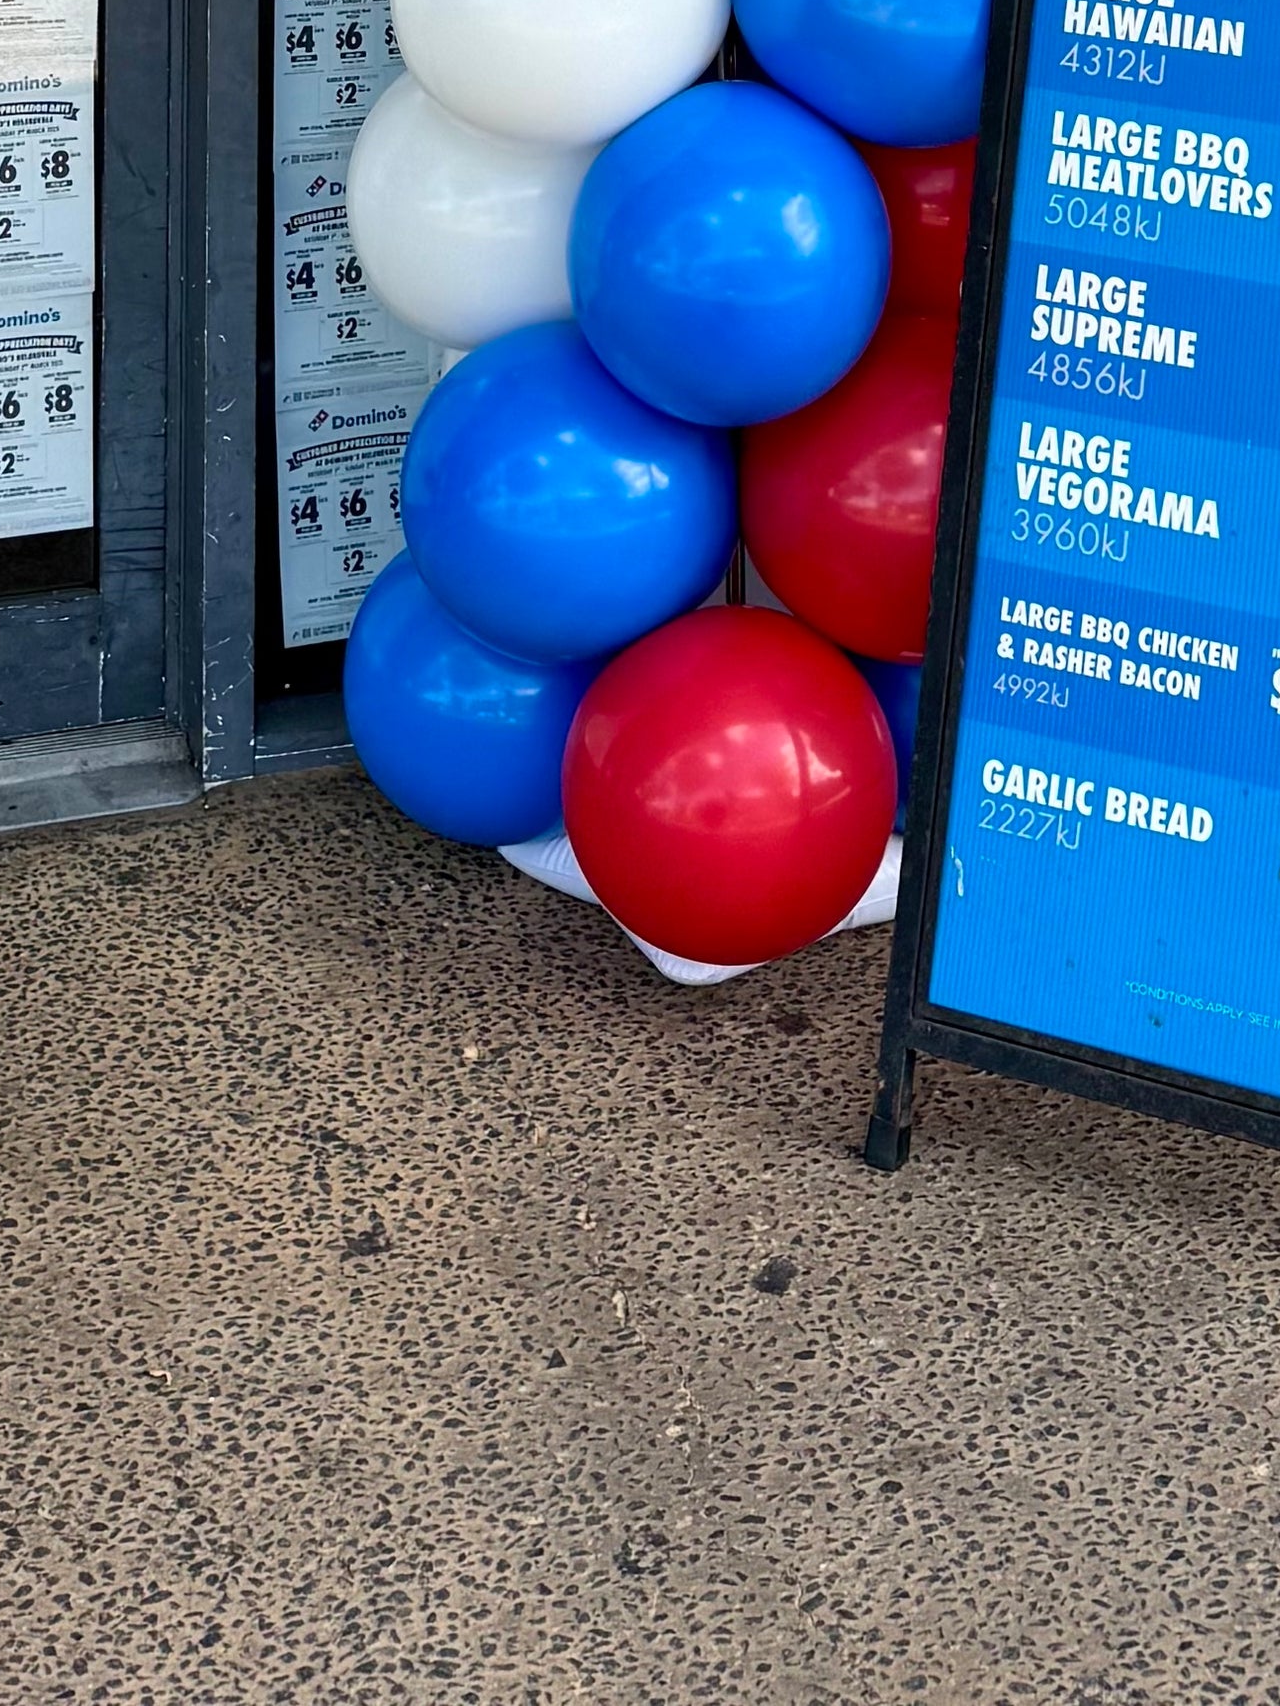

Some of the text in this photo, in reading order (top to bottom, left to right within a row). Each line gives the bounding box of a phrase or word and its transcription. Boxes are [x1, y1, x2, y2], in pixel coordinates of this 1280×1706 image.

[1063, 0, 1245, 57] HAWAIIAN
[1059, 42, 1166, 86] 4312kJ
[1052, 110, 1250, 178] LARGE BBQ
[1046, 149, 1274, 219] MEATLOVERS
[1043, 193, 1163, 242] 5048kJ
[1035, 264, 1148, 318] LARGE
[1030, 304, 1198, 369] SUPREME
[44, 384, 74, 414] $8
[1027, 350, 1147, 401] 4856kJ
[1019, 421, 1132, 478] LARGE
[1016, 461, 1221, 539] VEGORAMA
[1011, 508, 1129, 563] 3960kJ
[1000, 597, 1239, 671] LARGE BBQ CHICKEN
[992, 672, 1070, 709] 4992kJ
[997, 634, 1202, 701] & RASHER BACON
[979, 799, 1082, 850] 2227kJ
[982, 759, 1214, 843] GARLIC BREAD
[1205, 1002, 1243, 1020] APPLY
[1248, 1012, 1270, 1027] SEE
